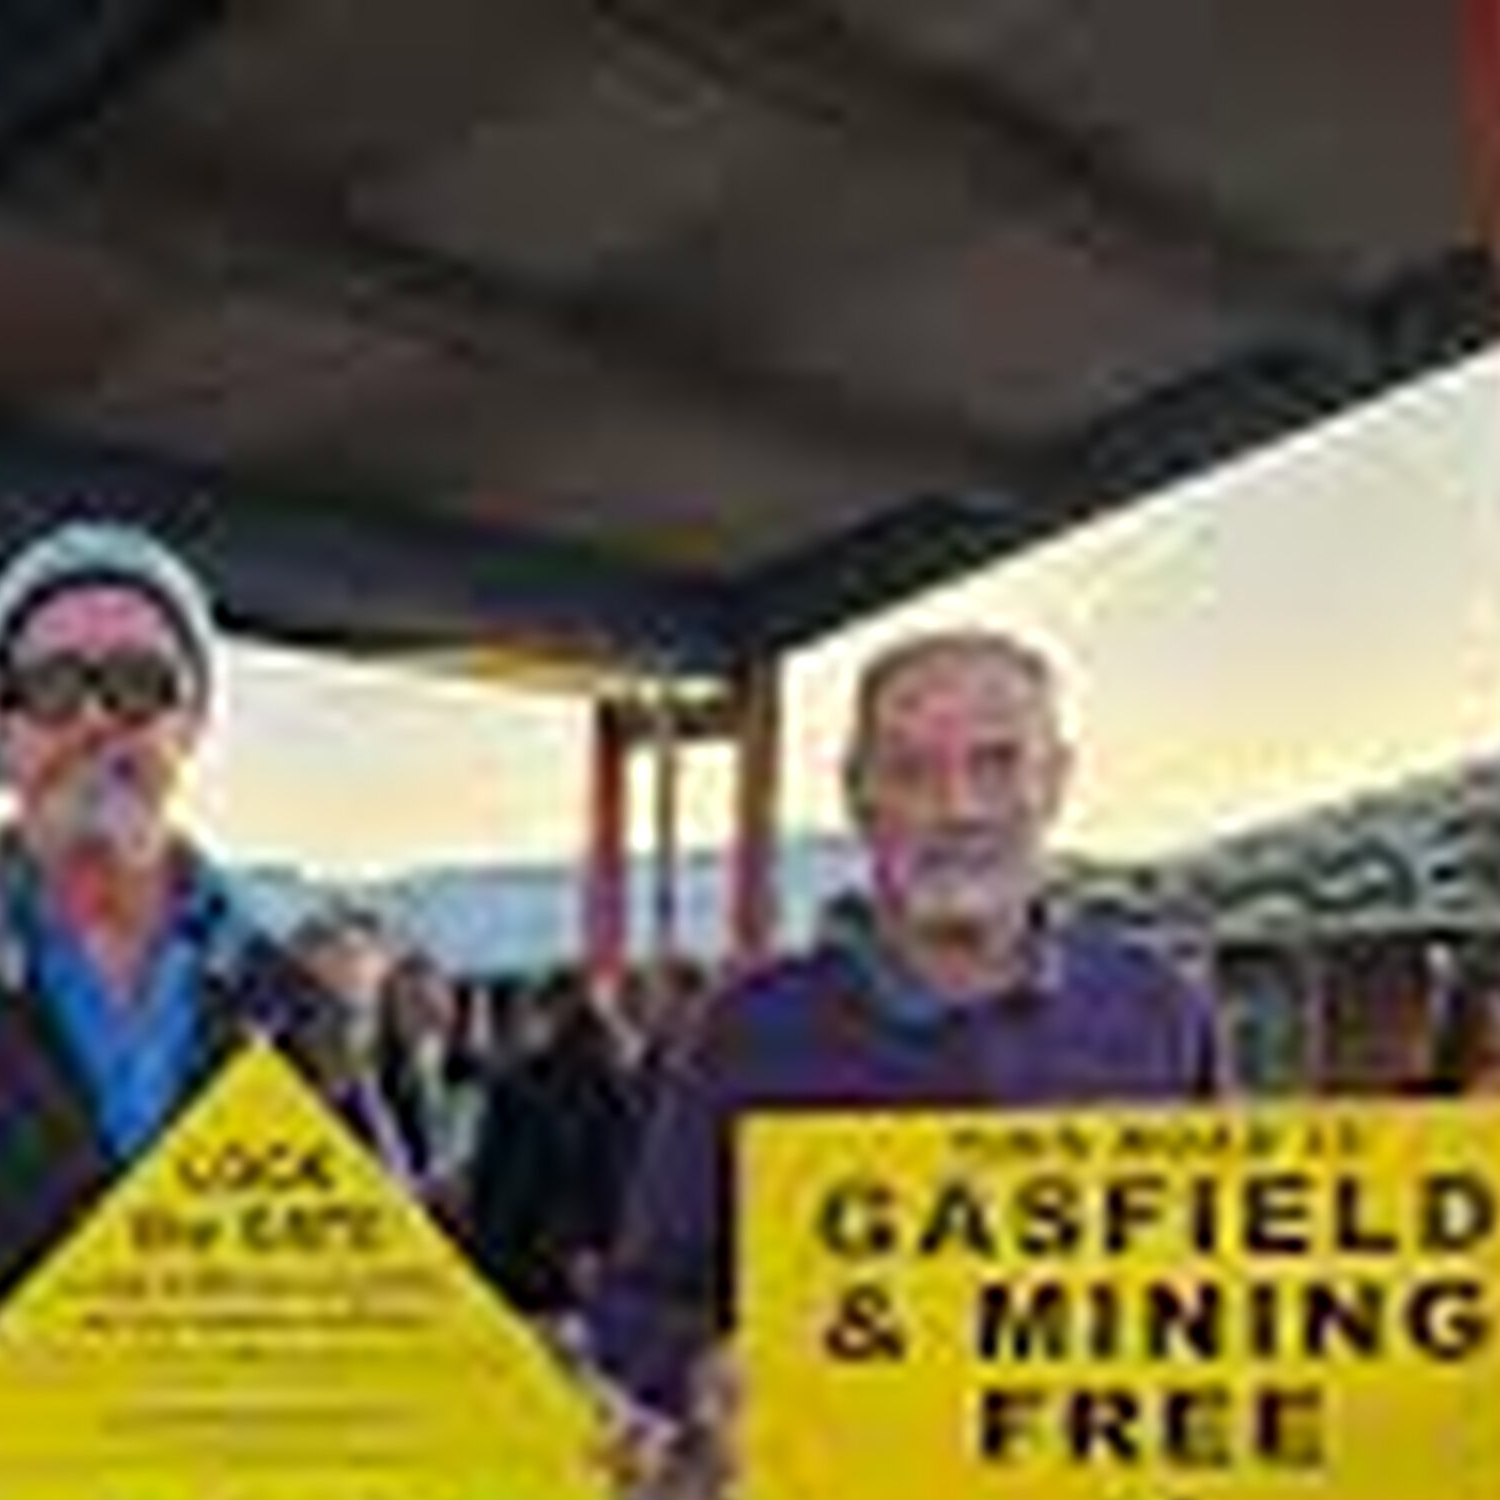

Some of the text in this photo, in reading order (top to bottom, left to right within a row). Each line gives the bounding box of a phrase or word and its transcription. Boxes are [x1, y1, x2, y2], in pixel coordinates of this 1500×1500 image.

[178, 1141, 333, 1192] LOCK
[817, 1172, 1496, 1258] GASFIELD
[823, 1279, 1490, 1363] & MINING
[979, 1385, 1324, 1468] FREE
